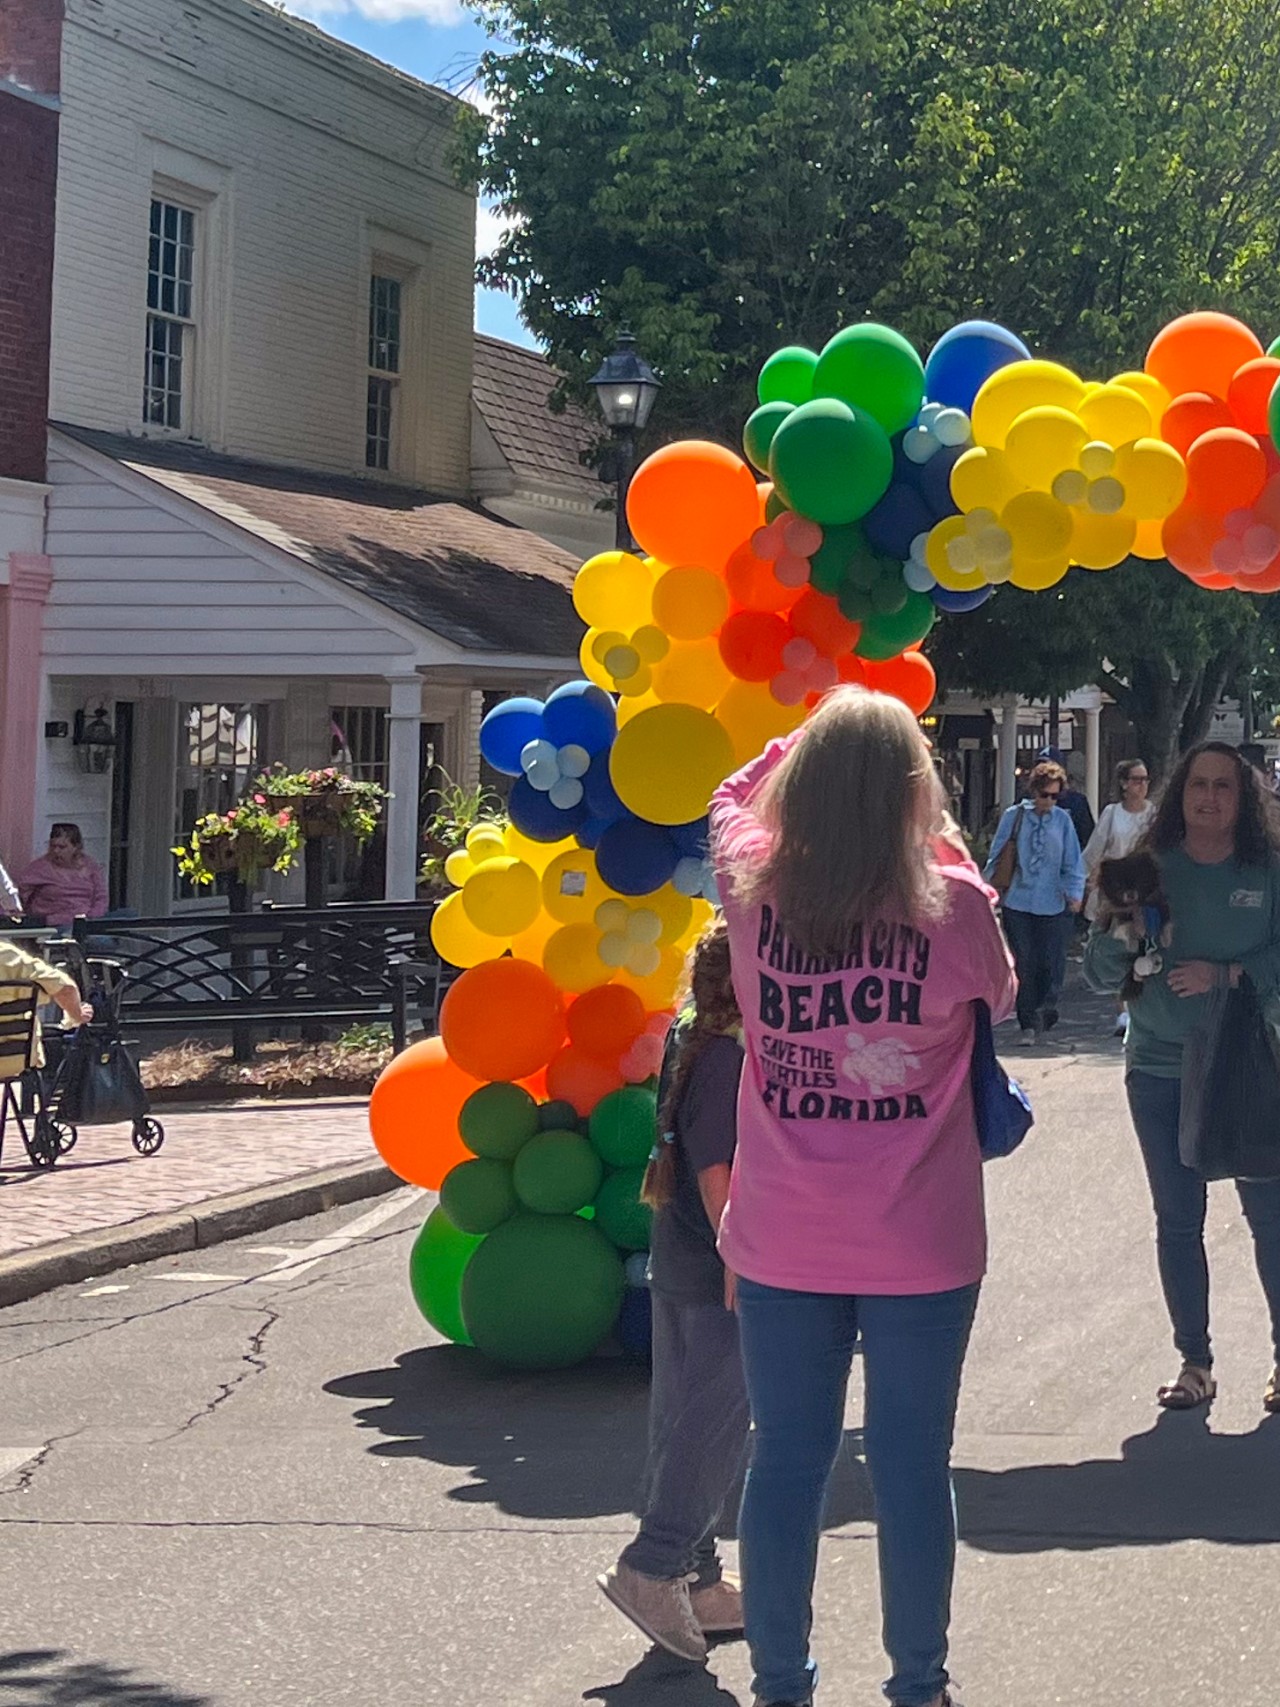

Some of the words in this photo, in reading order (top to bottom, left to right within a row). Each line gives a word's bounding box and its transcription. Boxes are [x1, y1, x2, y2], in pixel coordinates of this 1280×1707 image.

[757, 904, 863, 975] PANA
[867, 918, 930, 980] CITY
[759, 970, 922, 1033] BEACH
[761, 1035, 798, 1066] SAVE
[800, 1046, 835, 1070] THE
[762, 1080, 928, 1122] FLORIDA
